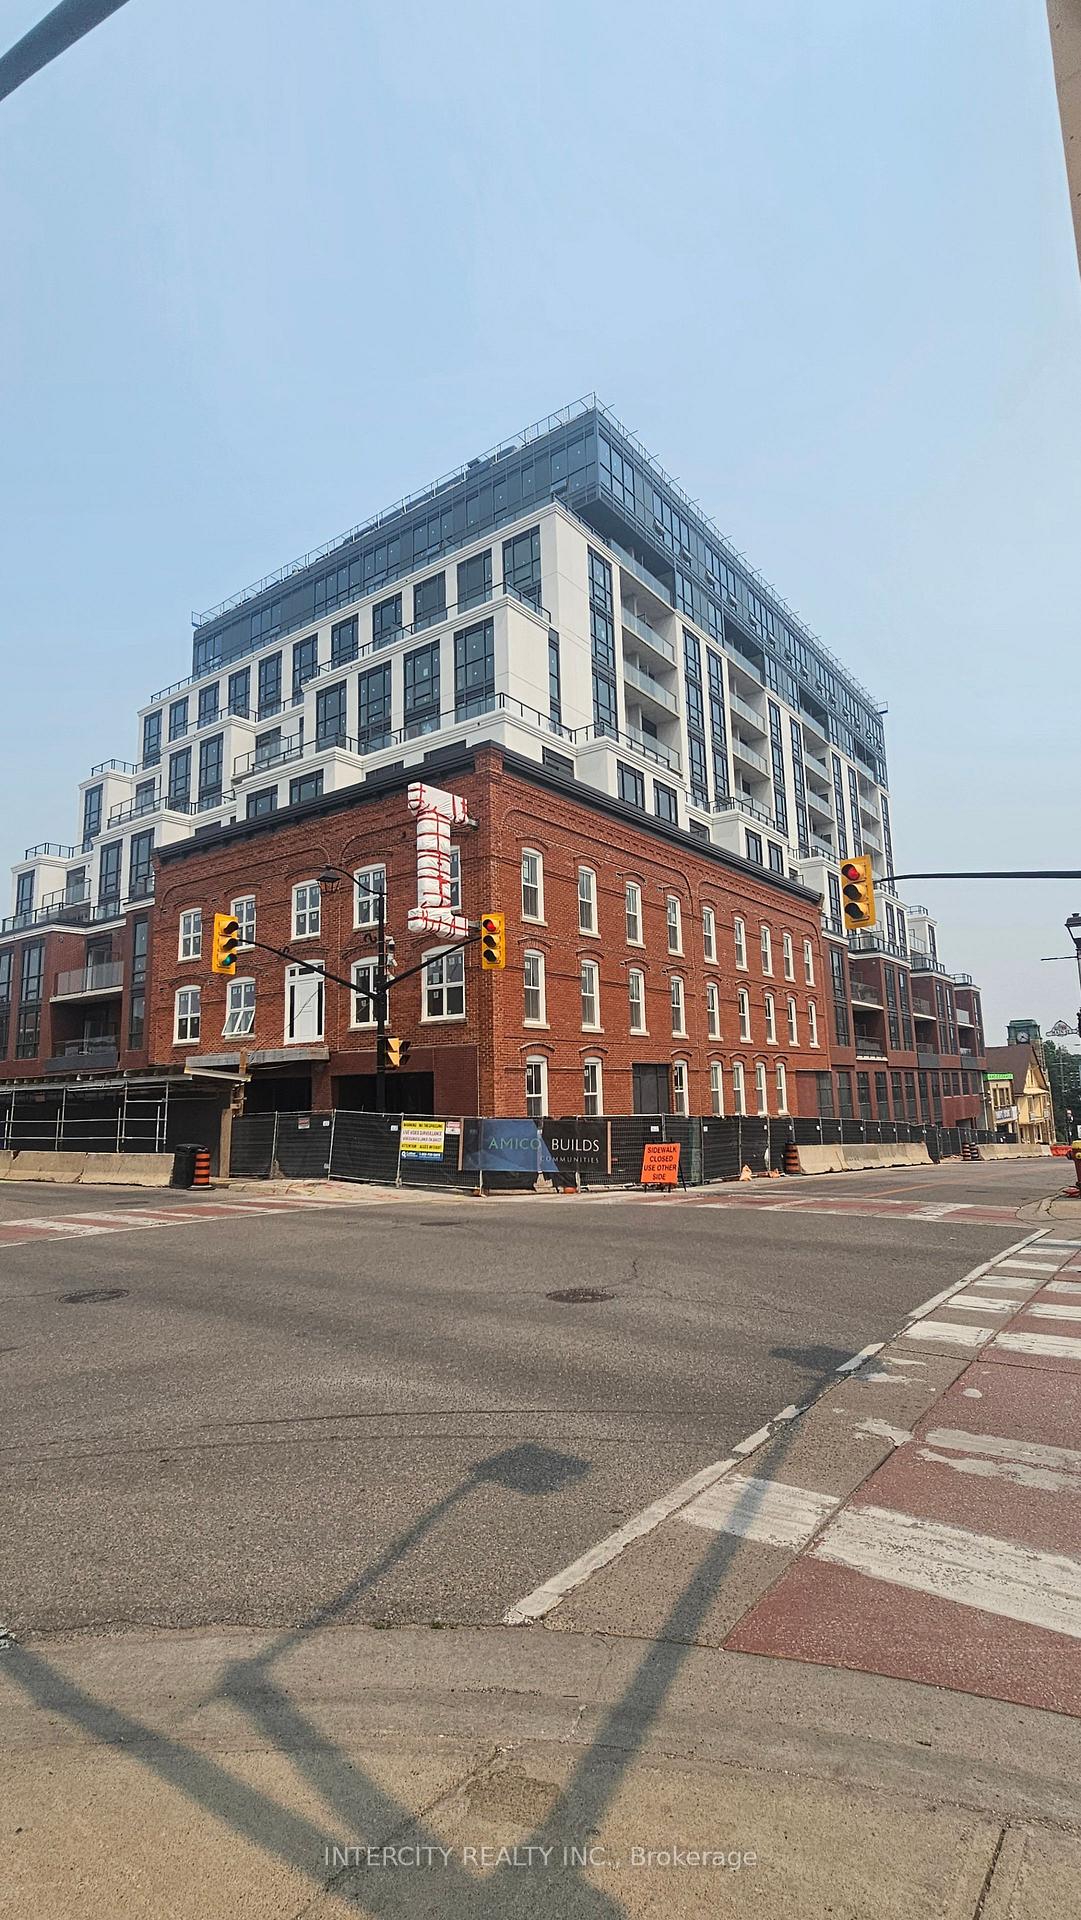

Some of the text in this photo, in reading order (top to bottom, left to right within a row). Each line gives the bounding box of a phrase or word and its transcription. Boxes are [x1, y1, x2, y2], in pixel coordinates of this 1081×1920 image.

[488, 1137, 600, 1152] AMICO BUILDS
[647, 1146, 677, 1154] SIDEWALK
[541, 1155, 599, 1164] COMMUNITIES
[649, 1155, 674, 1163] CLOSED
[643, 1164, 656, 1172] USE
[652, 1173, 666, 1181] SIDE
